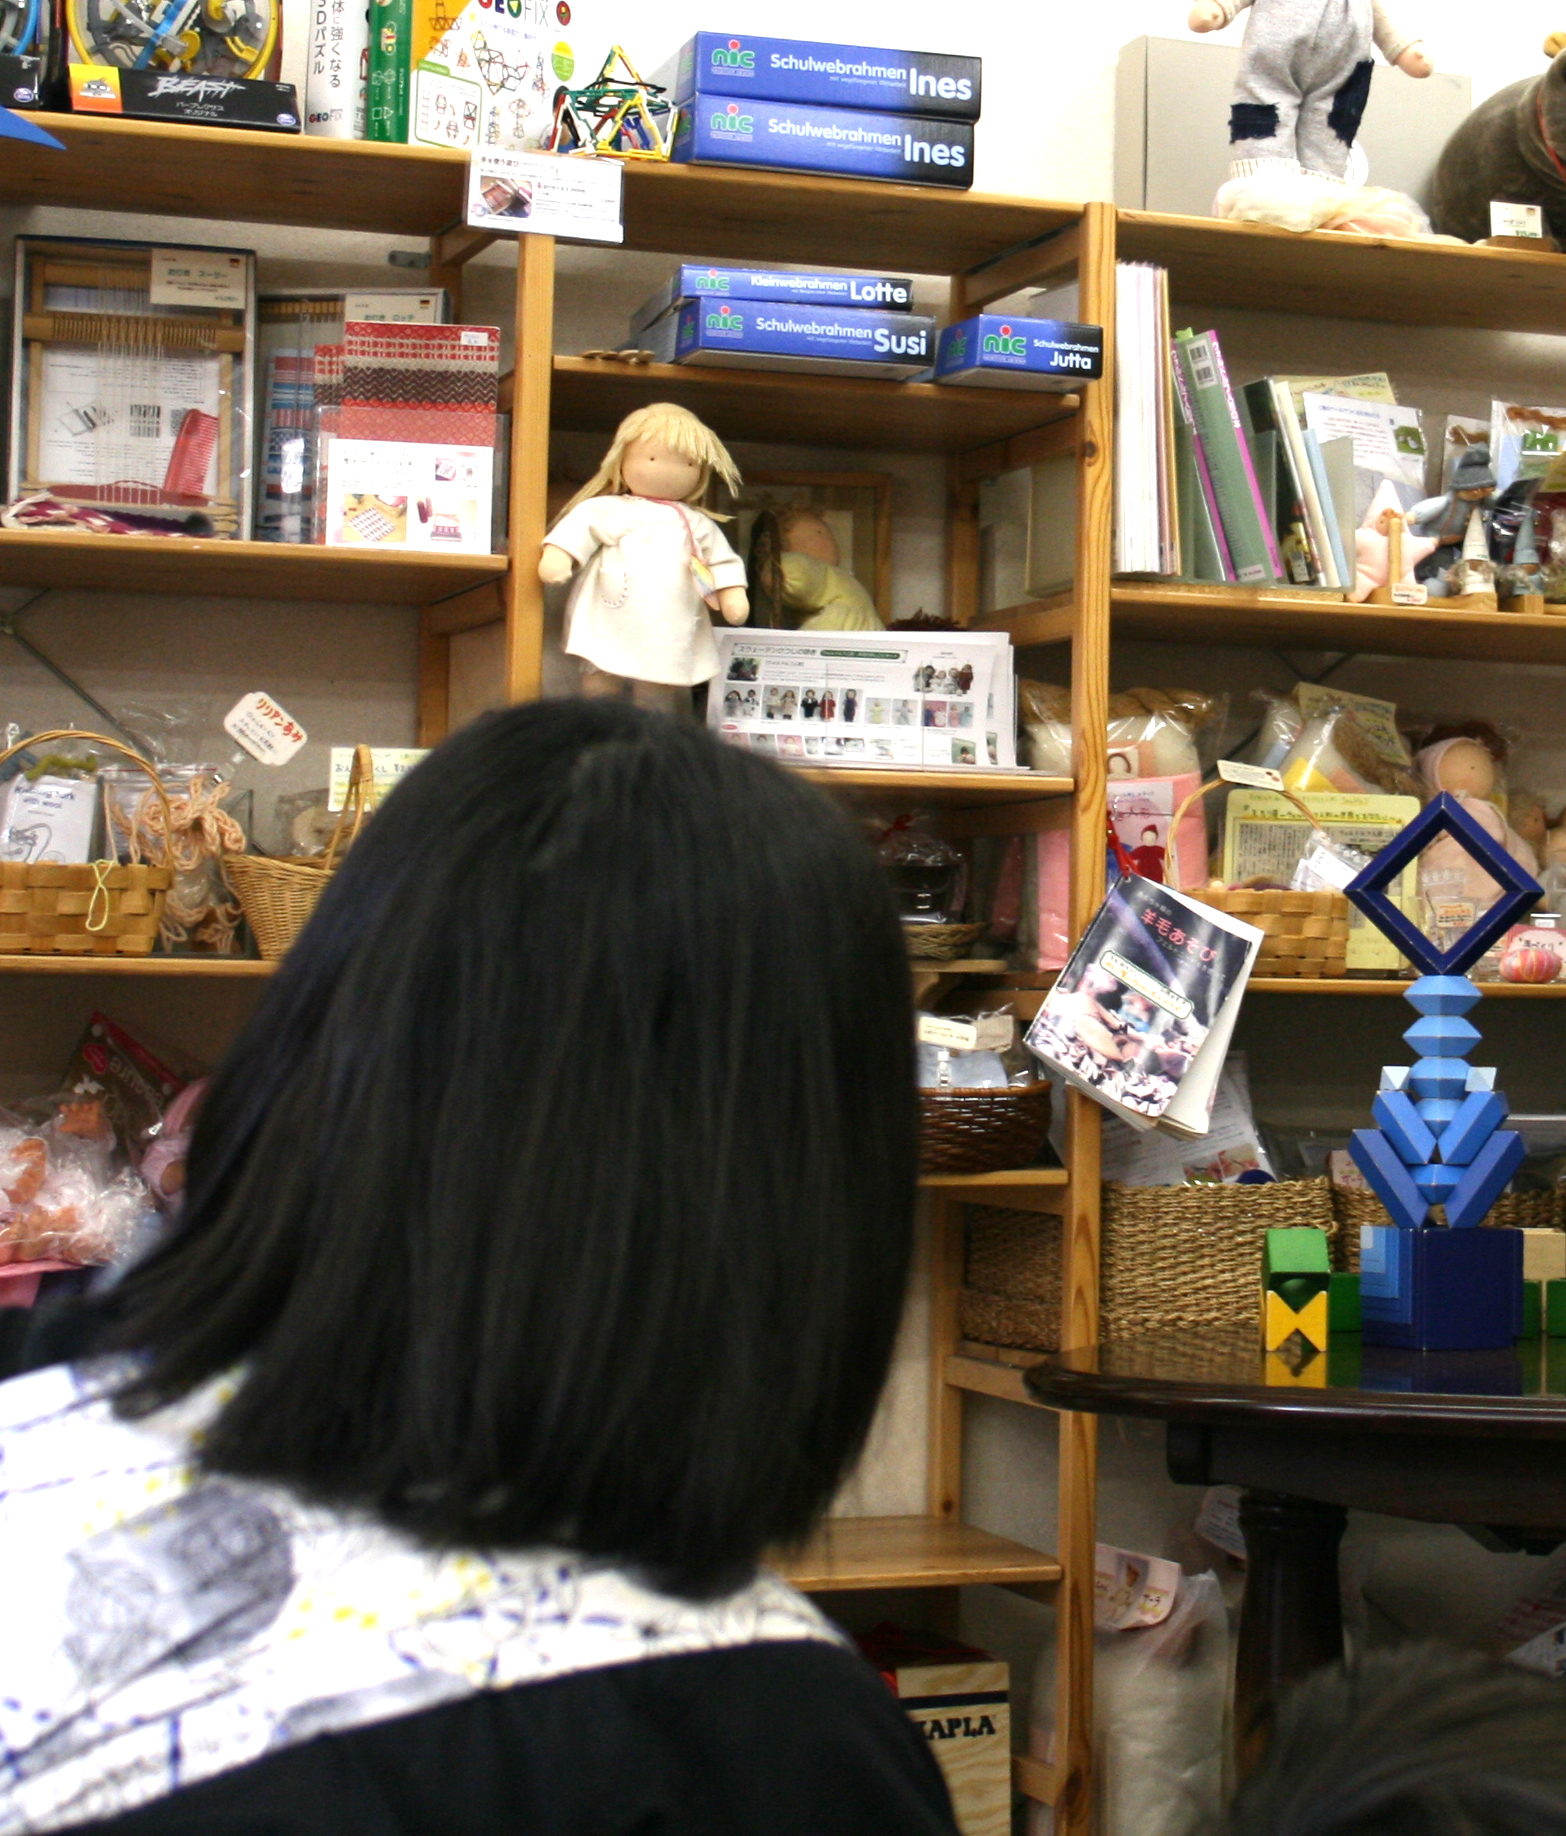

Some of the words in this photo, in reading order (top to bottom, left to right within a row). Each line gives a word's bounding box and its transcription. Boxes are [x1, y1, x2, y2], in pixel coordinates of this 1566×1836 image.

[711, 40, 756, 69] nic
[148, 75, 246, 102] BEAST
[770, 54, 907, 80] Schulwebrahmen
[909, 68, 973, 101] Ines
[309, 109, 344, 123] GEOFIX
[710, 104, 754, 134] nic
[768, 118, 902, 147] Schulwebrahmen
[904, 134, 965, 168] Ines
[696, 269, 730, 291] nic
[750, 275, 848, 291] Kleinwebrahmen
[850, 281, 908, 304] Lotte
[706, 306, 745, 332] nic
[756, 317, 872, 339] Schulwebrahmen
[873, 328, 928, 356] Susi
[983, 325, 1029, 356] nic
[1033, 338, 1100, 354] Schulwebrahmen
[1050, 351, 1093, 370] Jutta
[1140, 908, 1217, 962] 羊毛あそび
